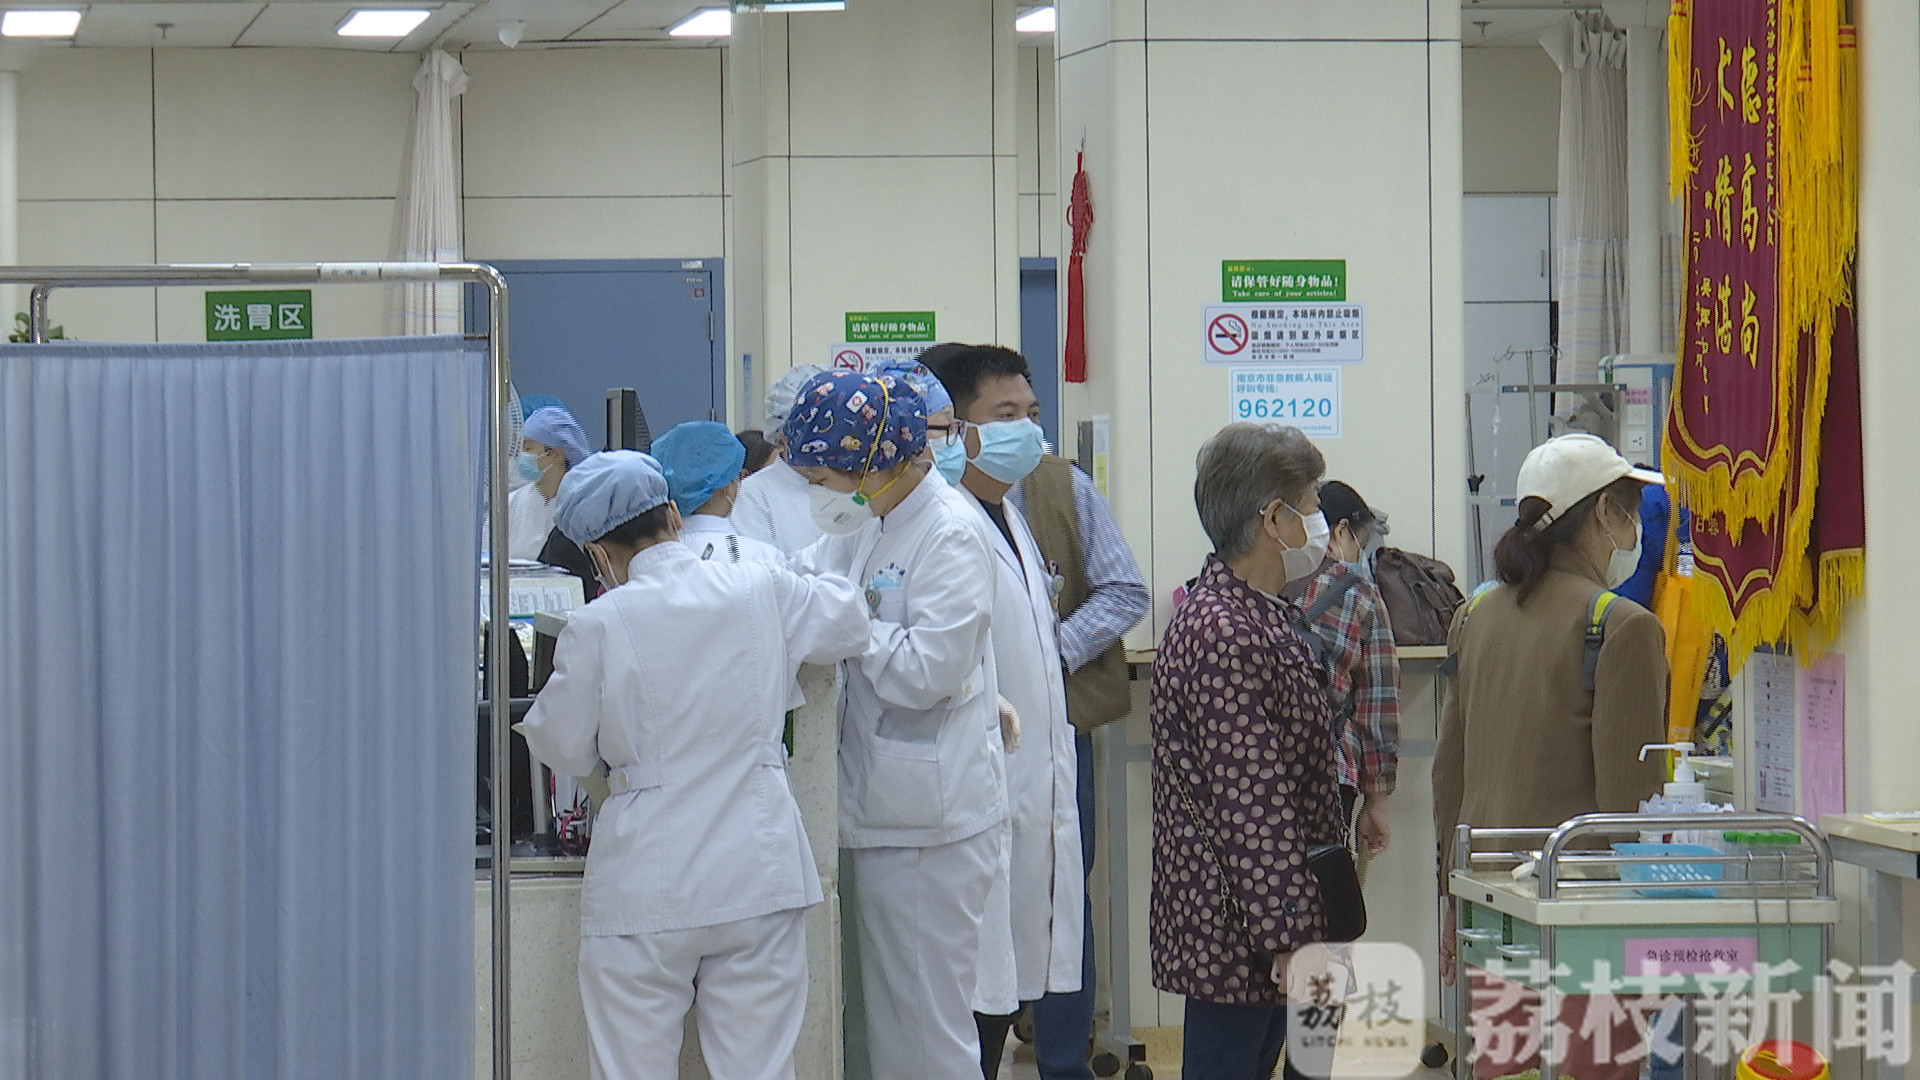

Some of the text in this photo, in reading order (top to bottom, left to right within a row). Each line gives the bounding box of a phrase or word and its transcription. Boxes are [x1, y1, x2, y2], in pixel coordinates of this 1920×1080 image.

[1232, 289, 1250, 297] Take
[1274, 289, 1283, 297] of
[214, 303, 305, 331] 洗胃区
[1238, 398, 1332, 418] 962120
[1646, 948, 1739, 963] 急诊预检抢救室
